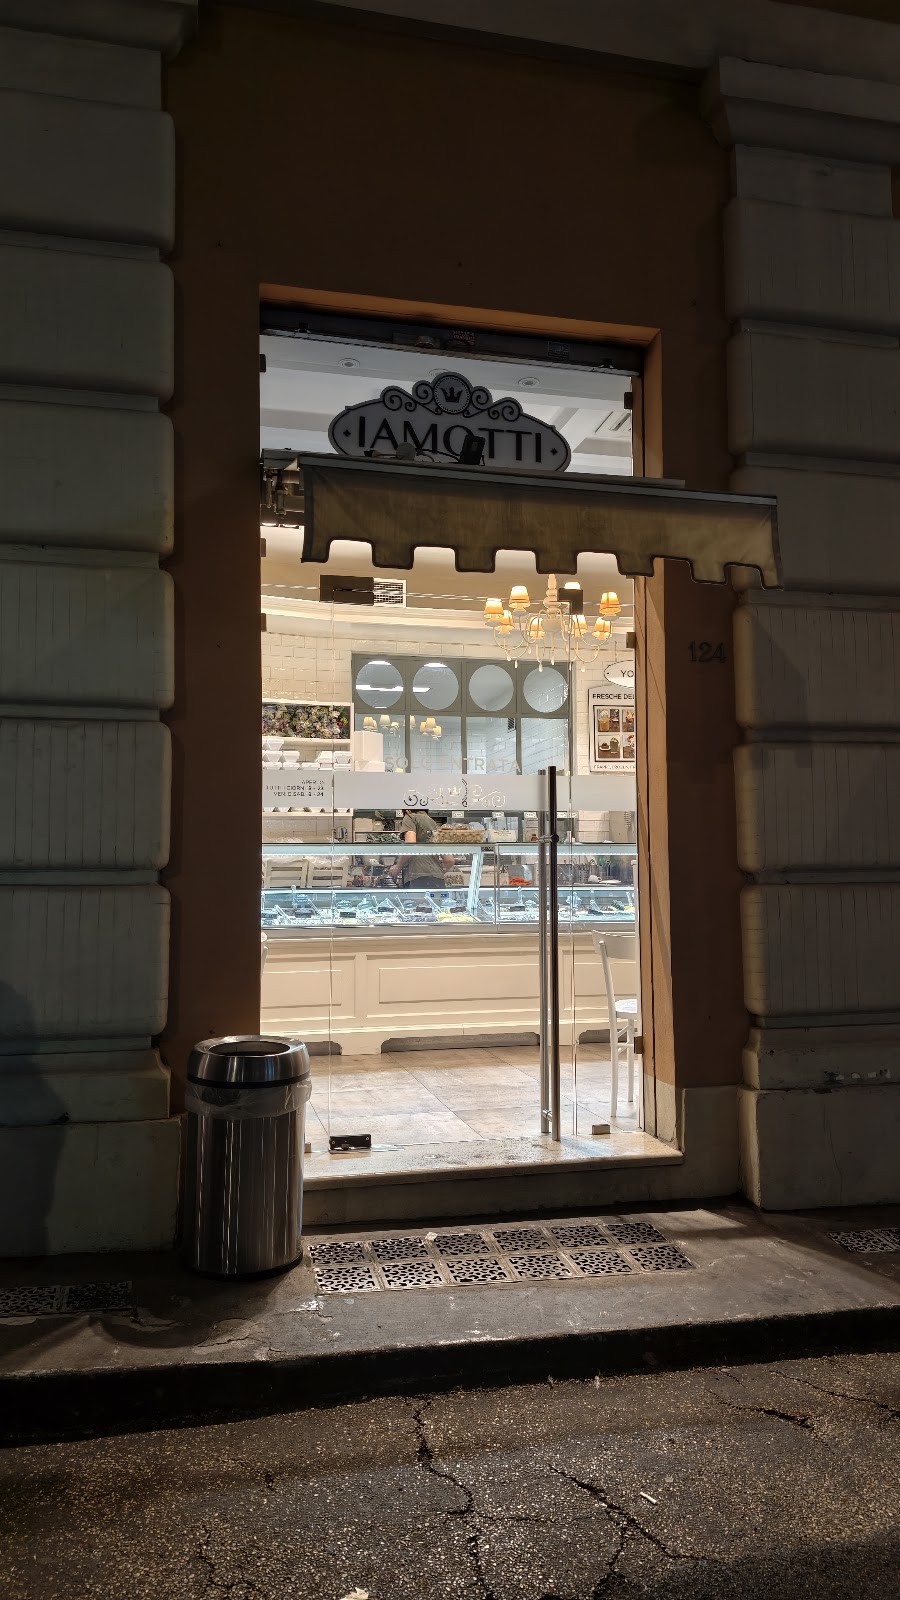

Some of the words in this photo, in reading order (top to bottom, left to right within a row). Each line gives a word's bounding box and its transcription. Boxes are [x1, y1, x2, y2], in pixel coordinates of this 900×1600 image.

[358, 415, 542, 463] IAMOTTI
[688, 640, 727, 663] 124
[440, 757, 522, 773] ENTRATA
